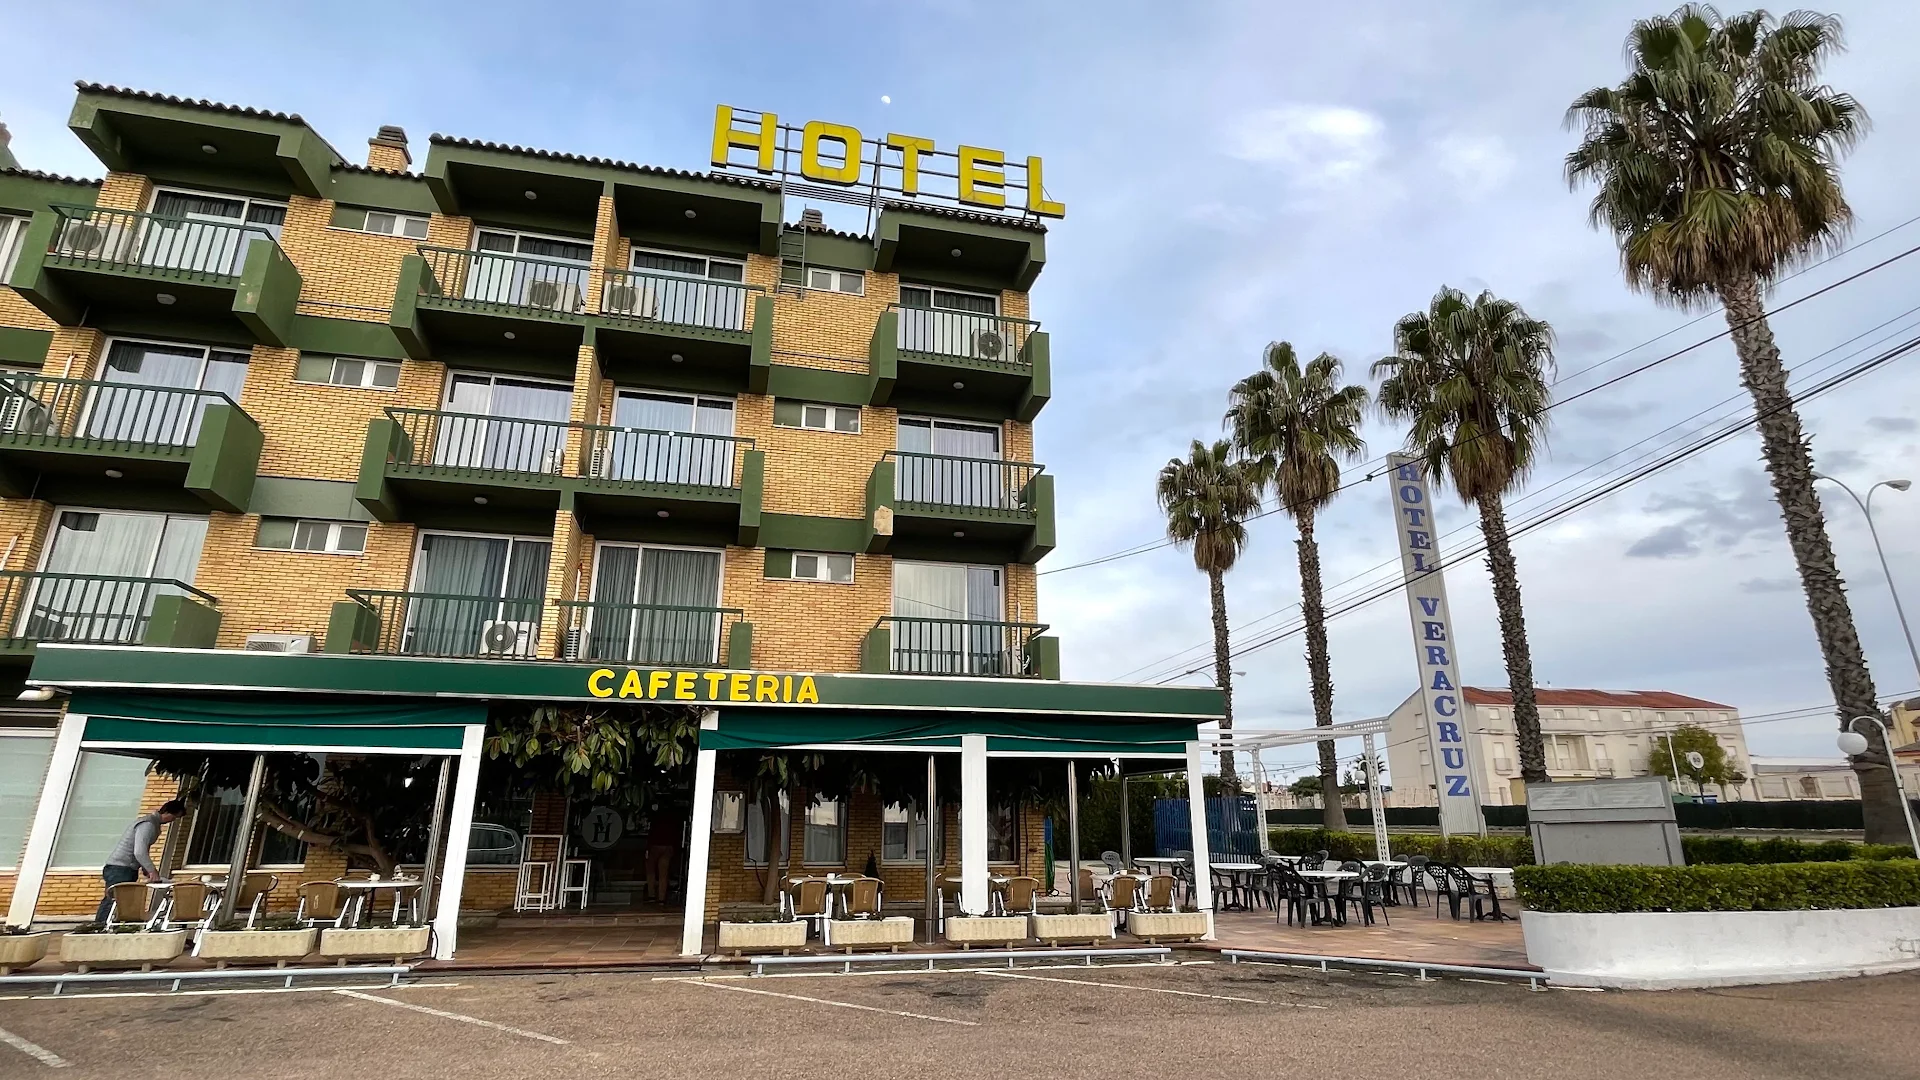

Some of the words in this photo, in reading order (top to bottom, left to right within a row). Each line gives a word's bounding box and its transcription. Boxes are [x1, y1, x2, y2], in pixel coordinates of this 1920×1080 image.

[711, 104, 1066, 219] HOTEL
[587, 668, 819, 704] CAFETERIA
[1395, 463, 1434, 573] HOTEL
[1417, 597, 1471, 797] VERACRUZ
